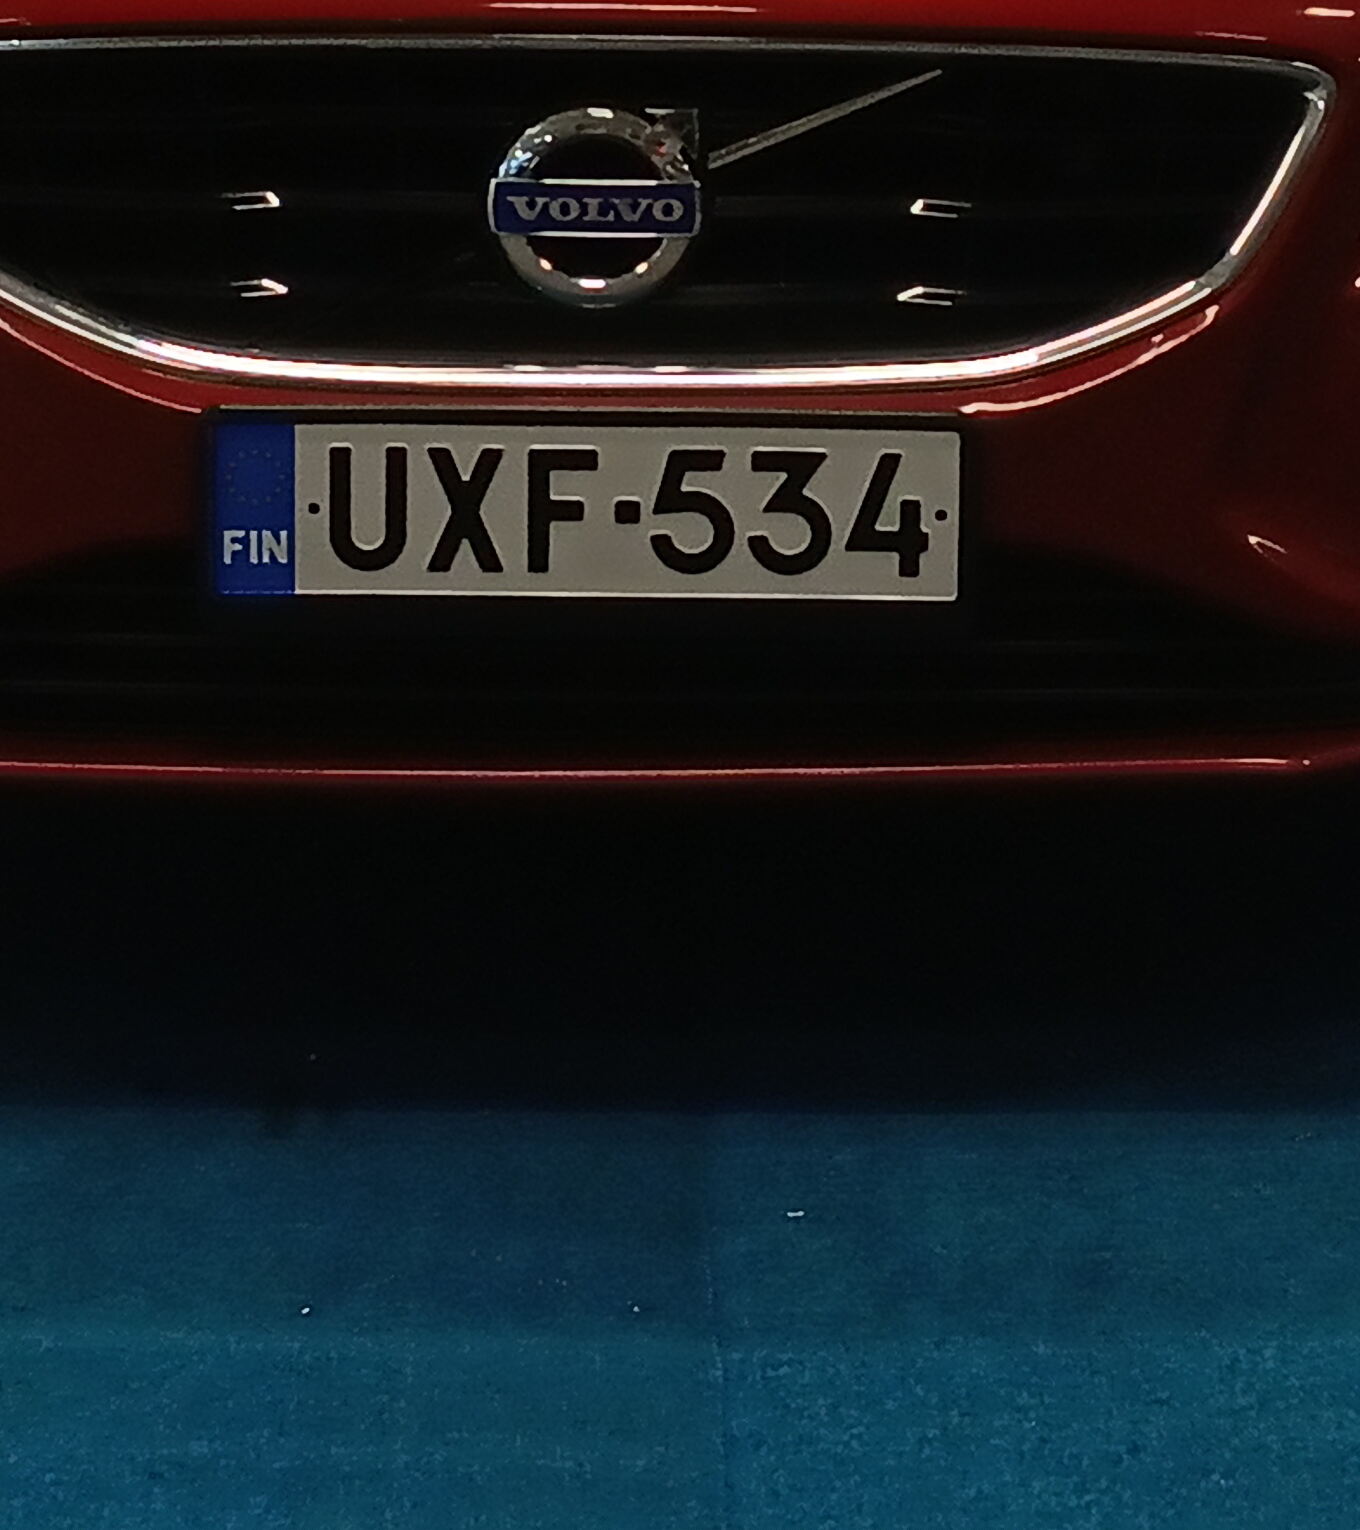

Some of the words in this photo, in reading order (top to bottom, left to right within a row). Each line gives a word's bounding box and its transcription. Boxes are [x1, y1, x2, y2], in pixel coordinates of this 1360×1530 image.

[506, 196, 684, 222] VOLVO
[327, 443, 930, 578] UXF-534
[222, 529, 289, 565] FIN
